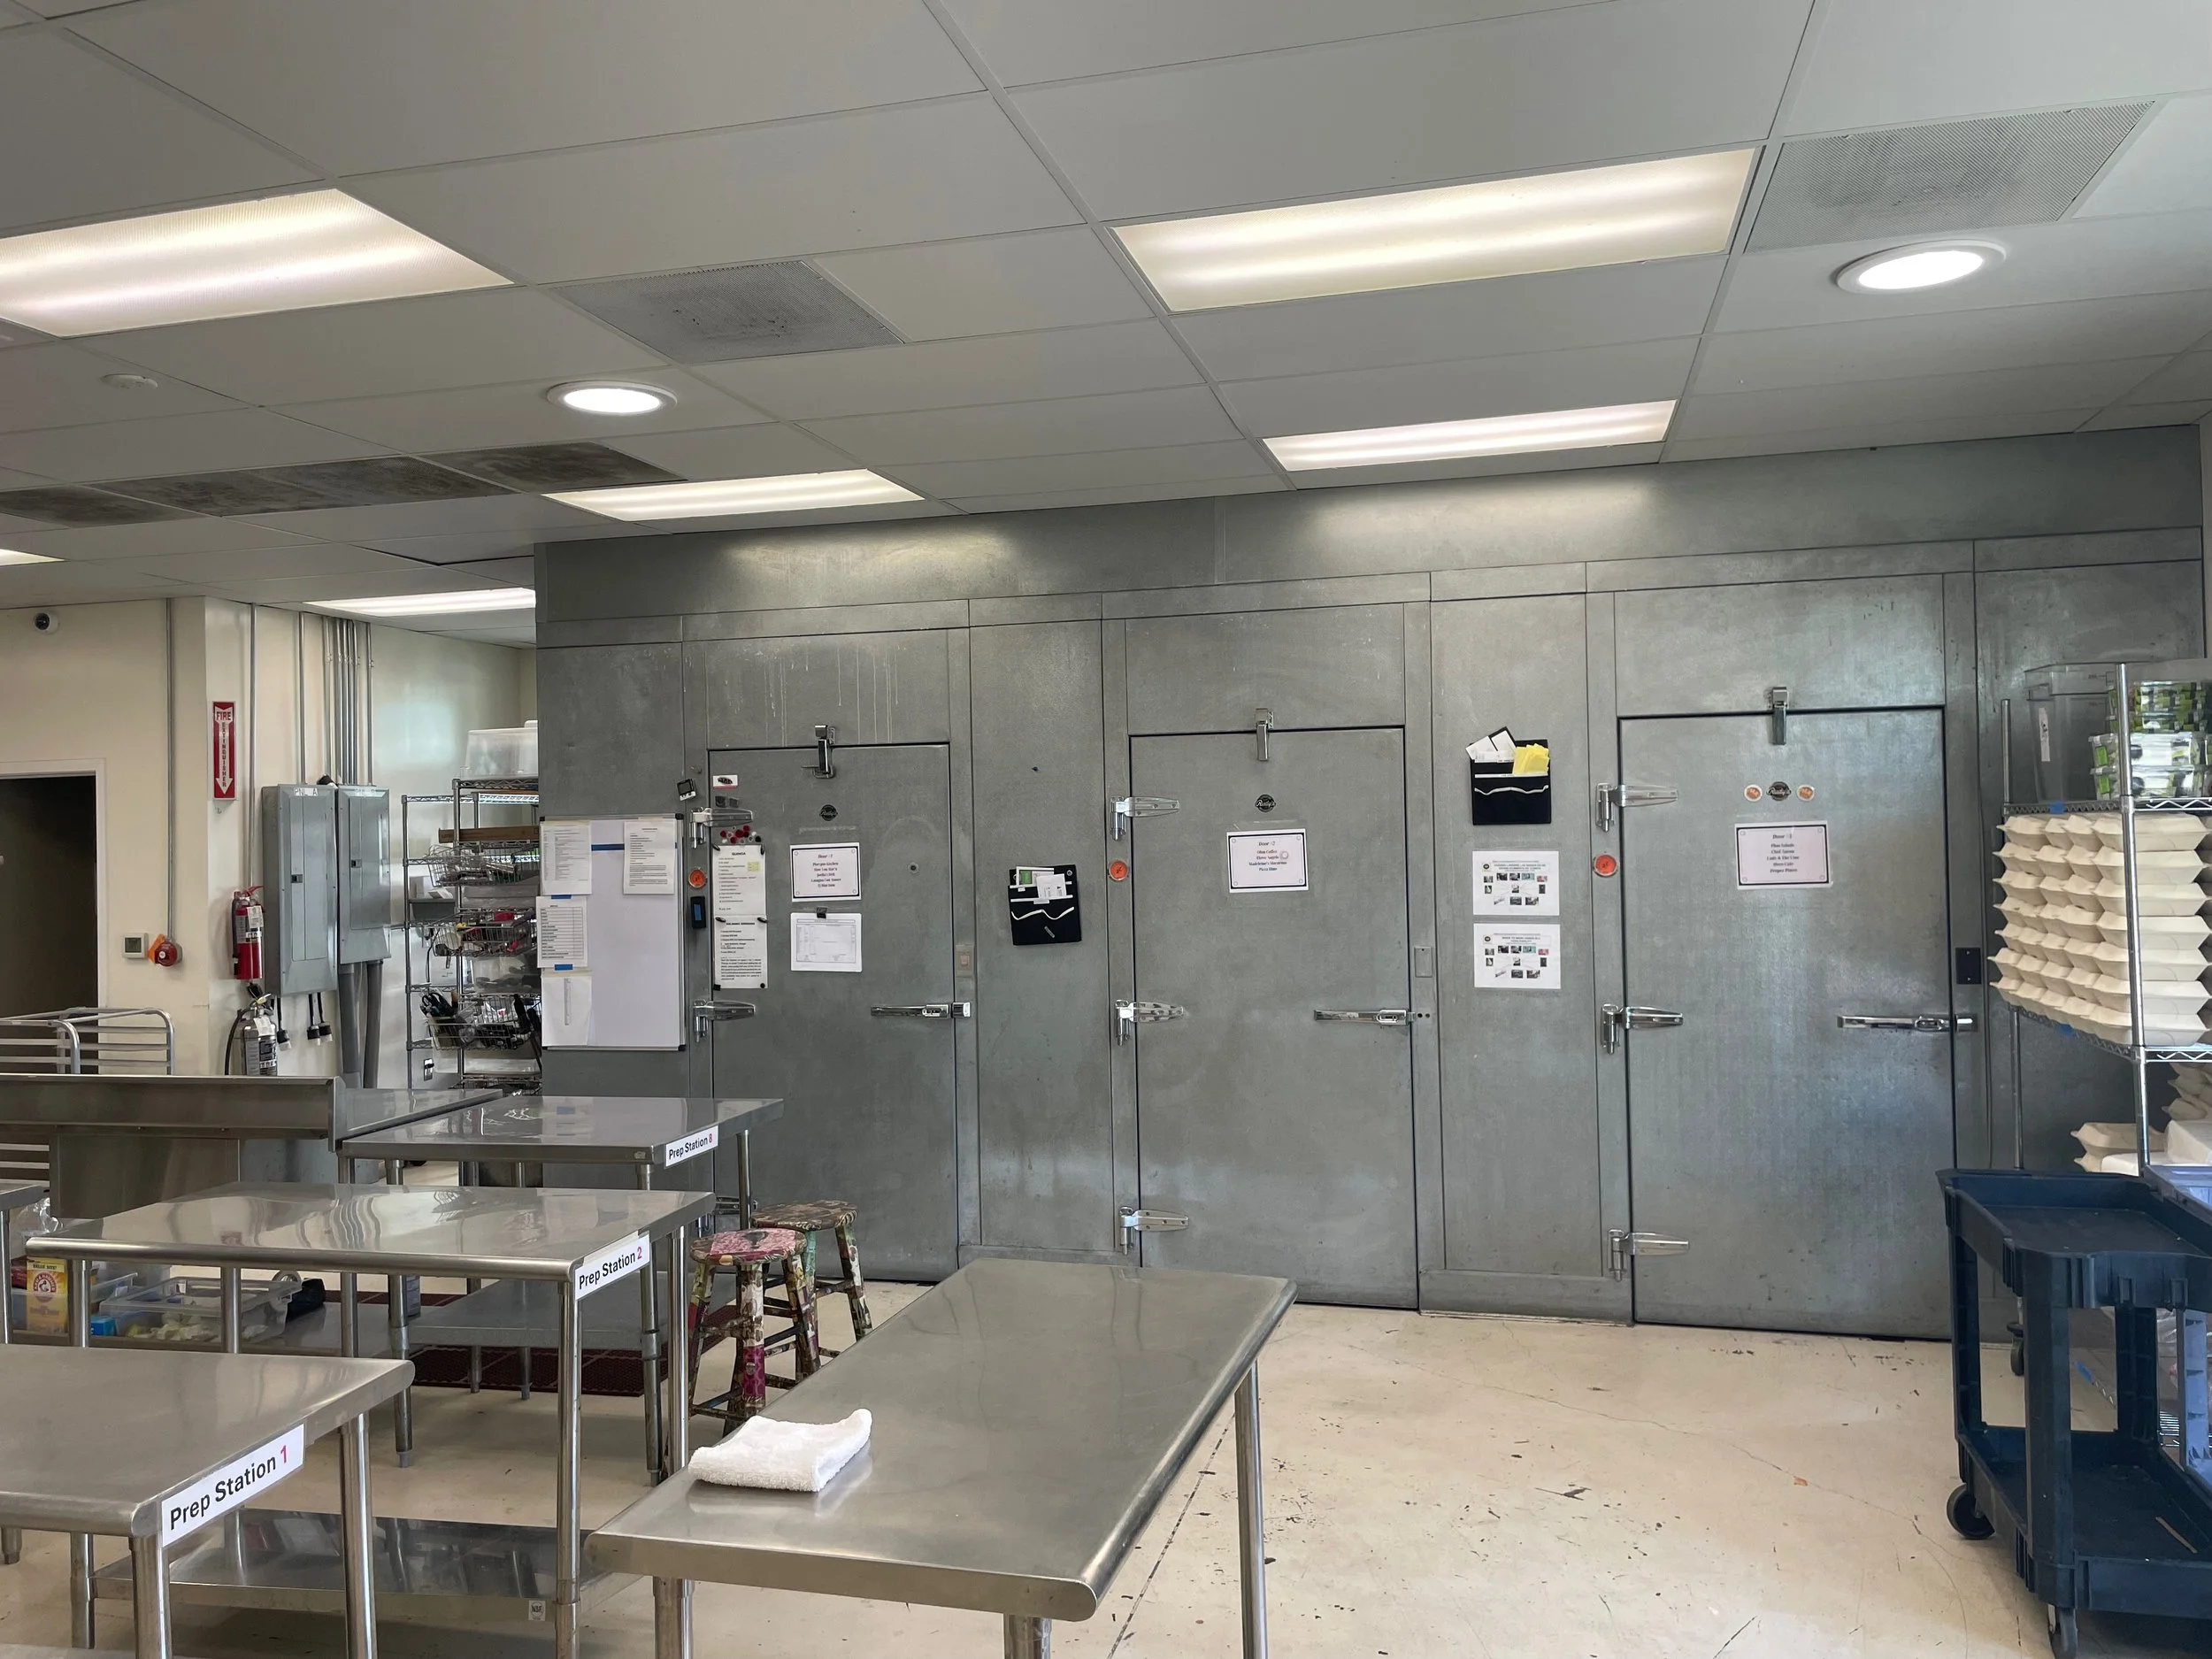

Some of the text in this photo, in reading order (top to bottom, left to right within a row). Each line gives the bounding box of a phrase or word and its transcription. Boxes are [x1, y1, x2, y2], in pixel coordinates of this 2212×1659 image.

[216, 711, 232, 721] FIRE
[295, 787, 319, 796] PNL A
[669, 1133, 713, 1159] Prep Station 8
[580, 1247, 642, 1289] Prep Station 2
[171, 1445, 288, 1530] Prep Station 1
